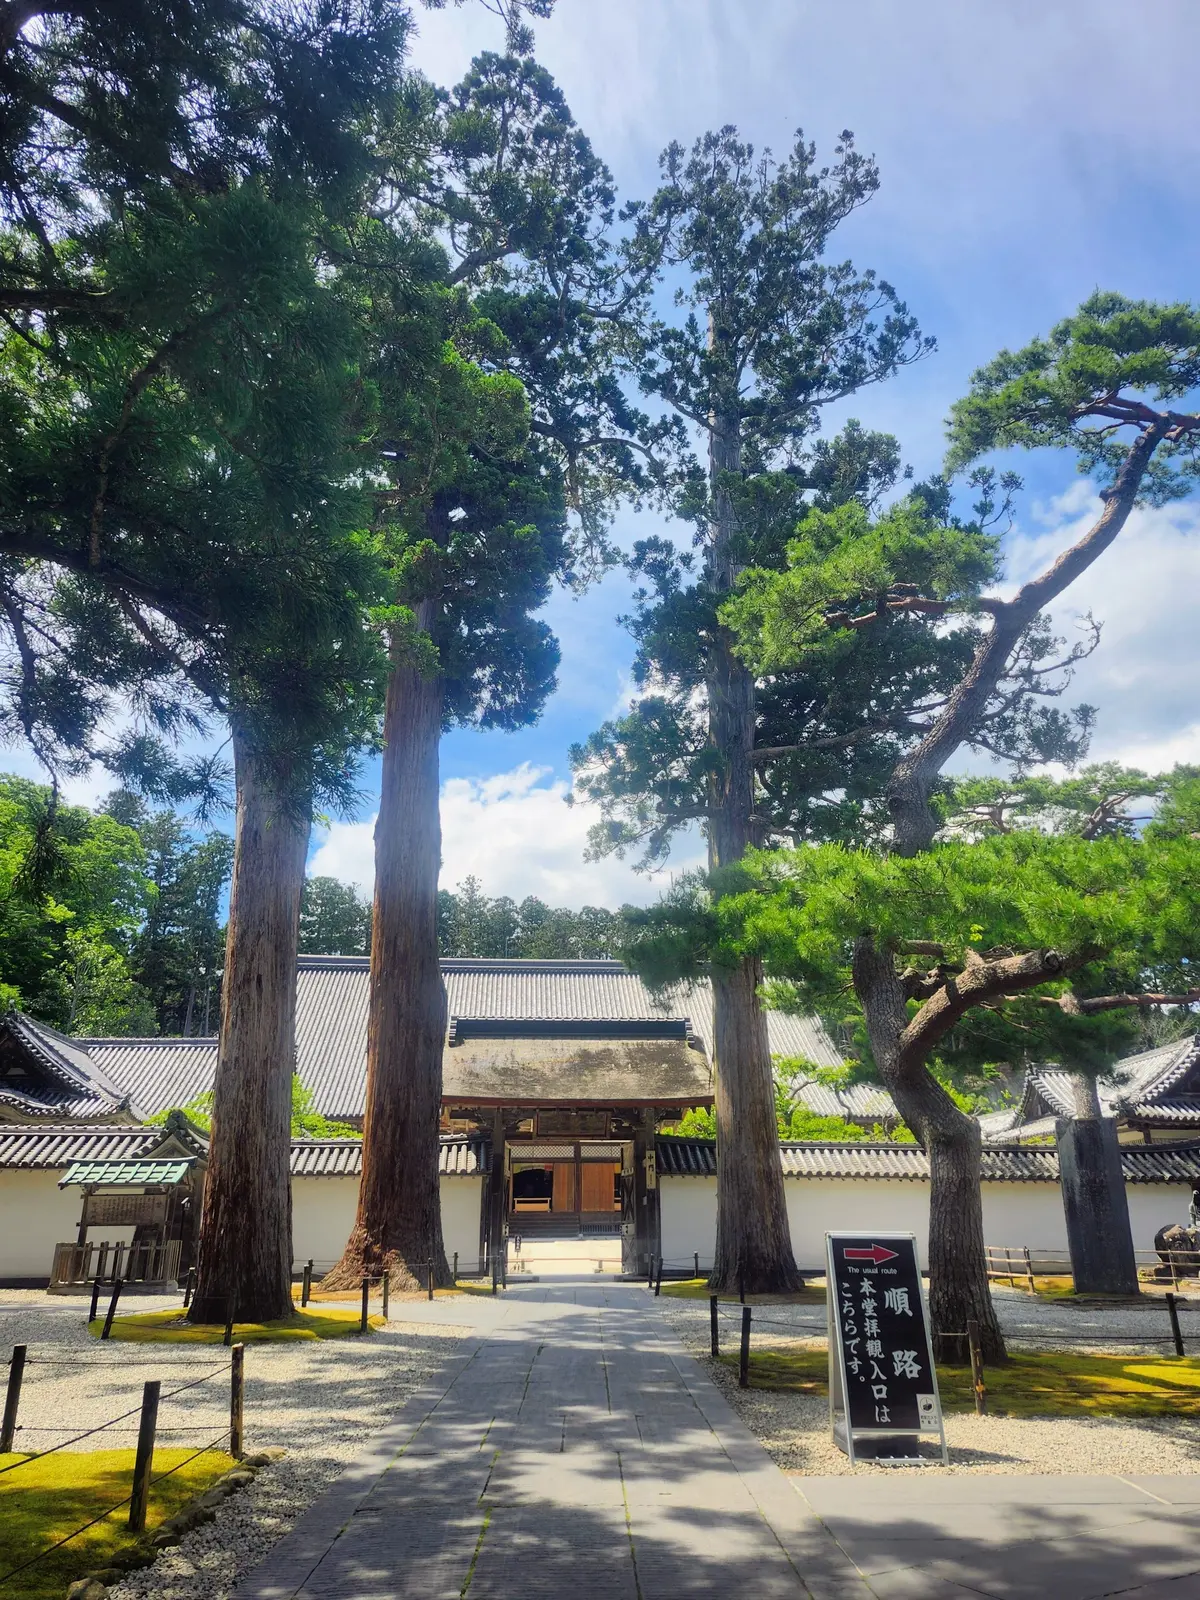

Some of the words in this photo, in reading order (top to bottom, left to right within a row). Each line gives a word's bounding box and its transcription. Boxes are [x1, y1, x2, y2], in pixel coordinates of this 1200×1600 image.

[847, 1266, 860, 1274] The
[881, 1267, 898, 1275] route
[841, 1282, 866, 1382] こちらです。
[860, 1277, 891, 1423] 本堂拝観入口は
[883, 1287, 922, 1379] 順路
